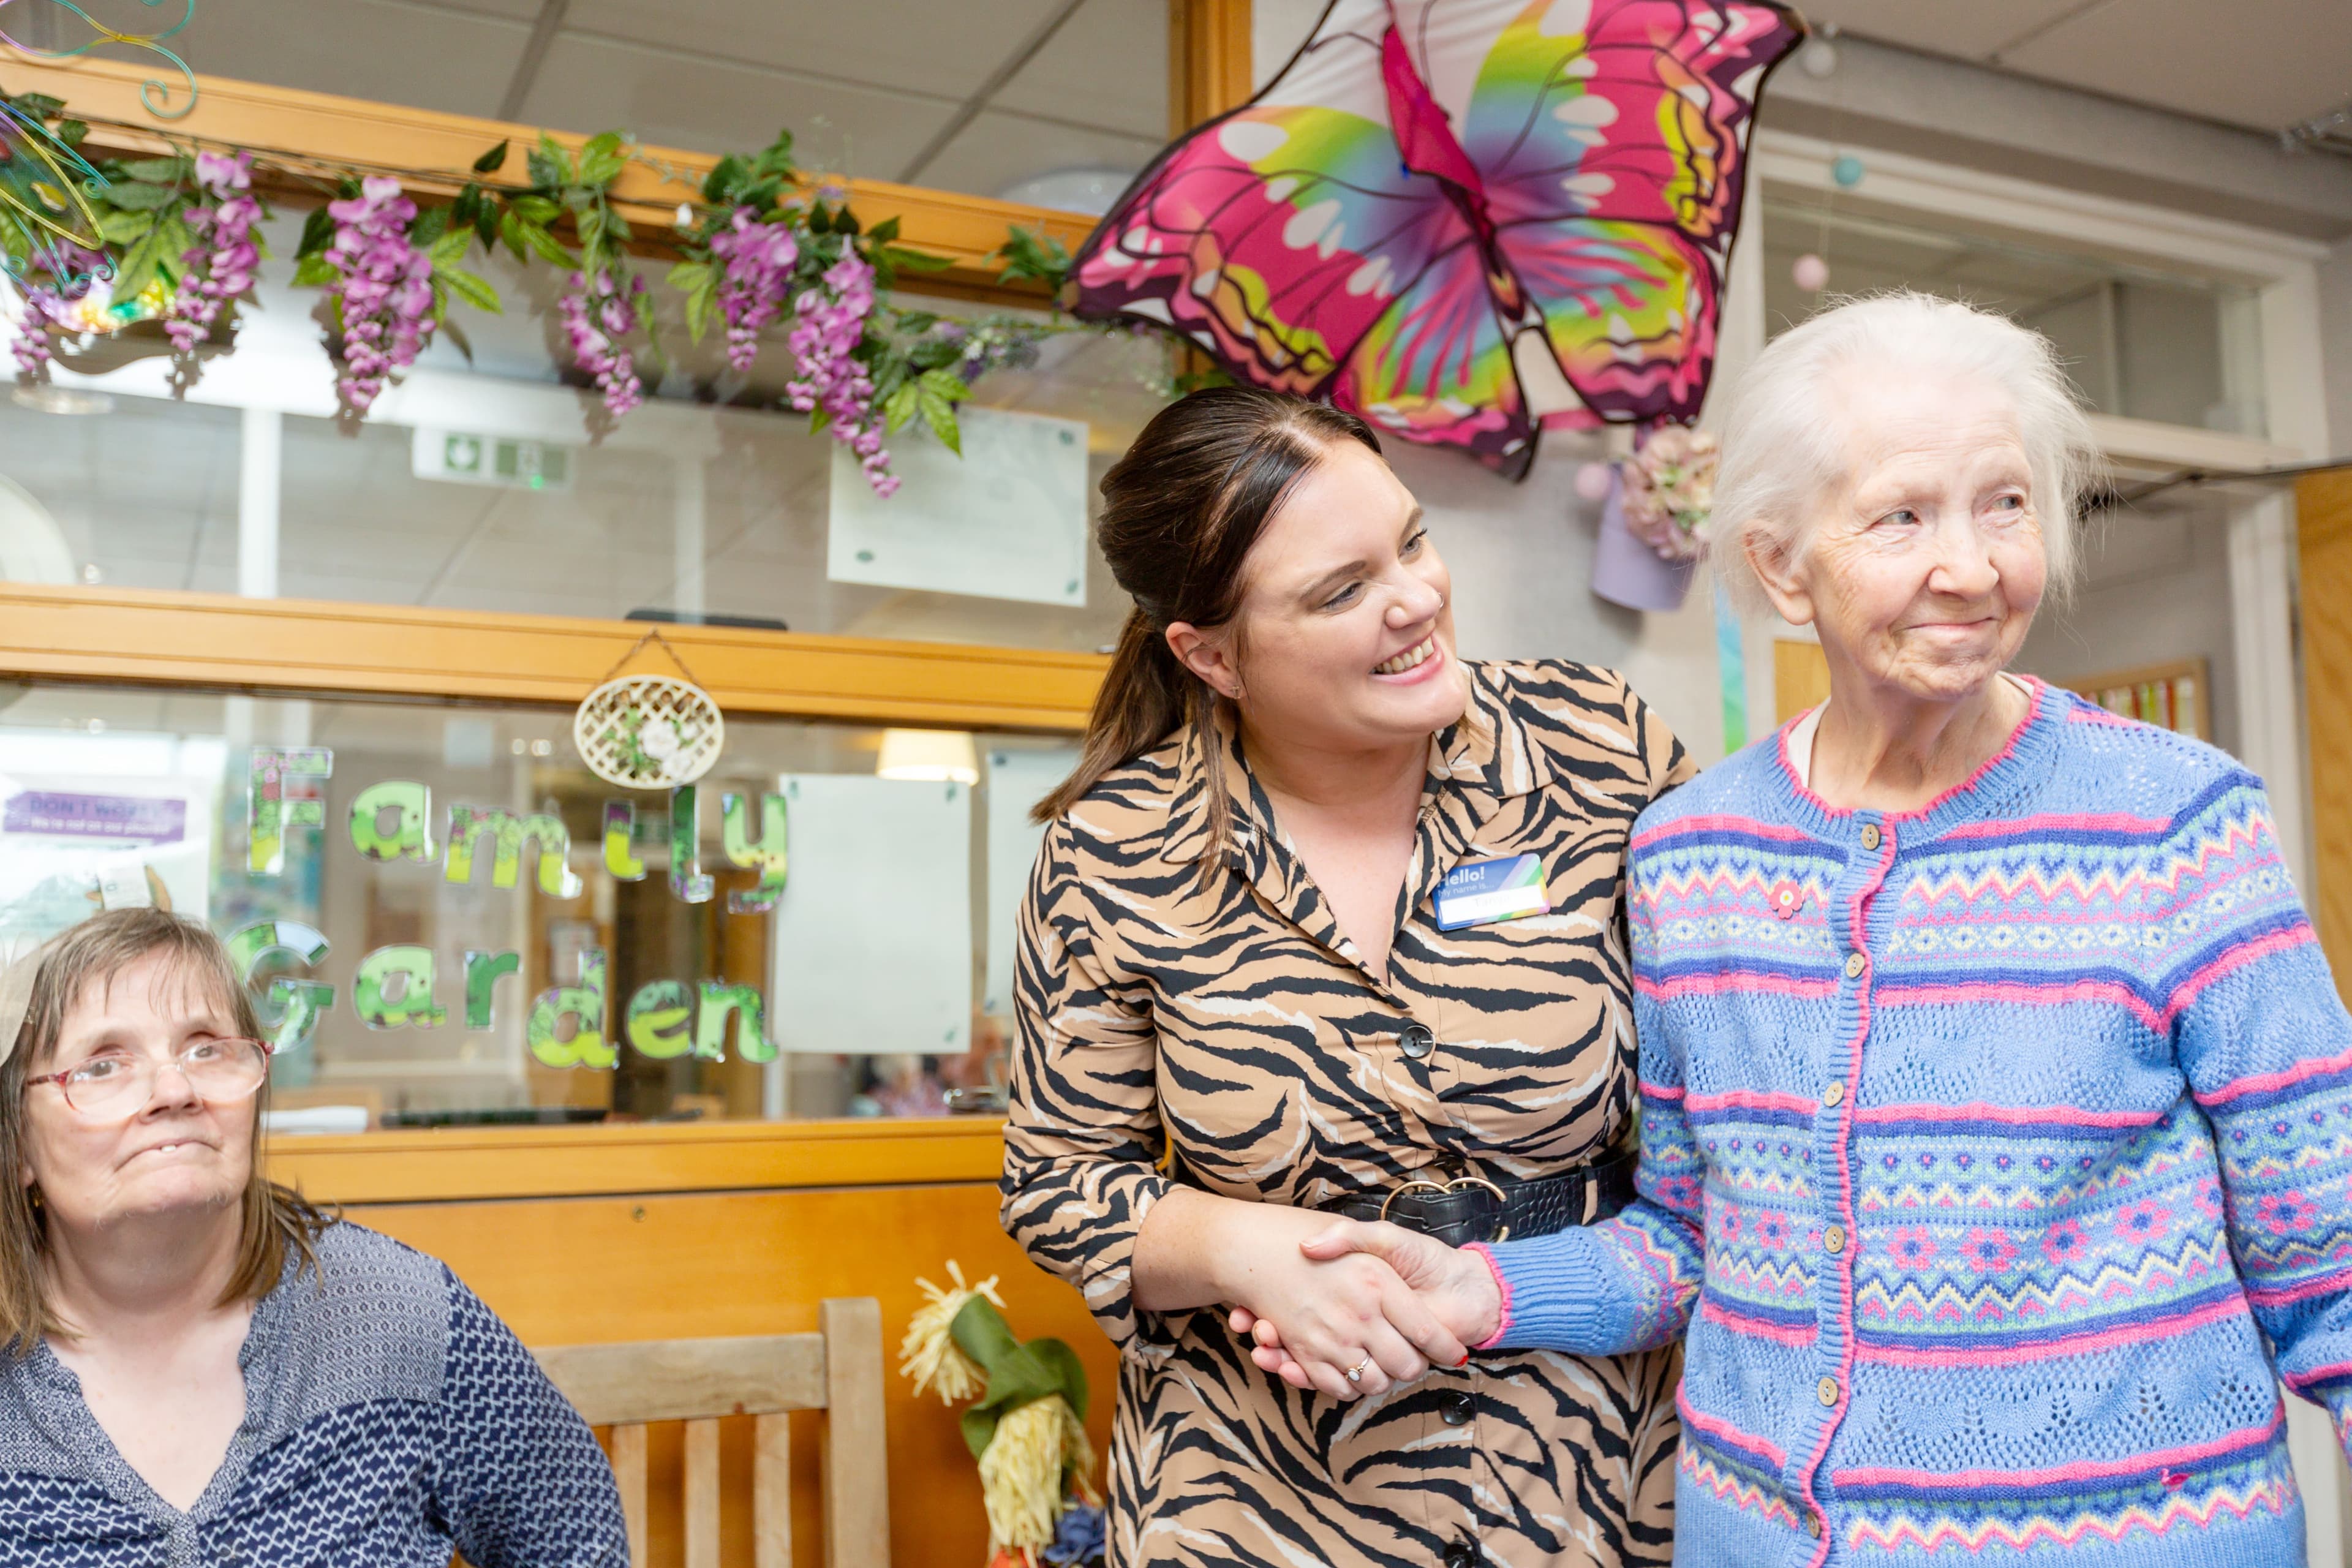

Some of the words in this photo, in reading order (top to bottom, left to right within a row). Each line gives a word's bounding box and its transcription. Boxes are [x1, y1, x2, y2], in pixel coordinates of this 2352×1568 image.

[246, 747, 789, 914] Family
[1438, 888, 1451, 897] My
[1453, 885, 1477, 894] name
[223, 919, 778, 1071] Garden
